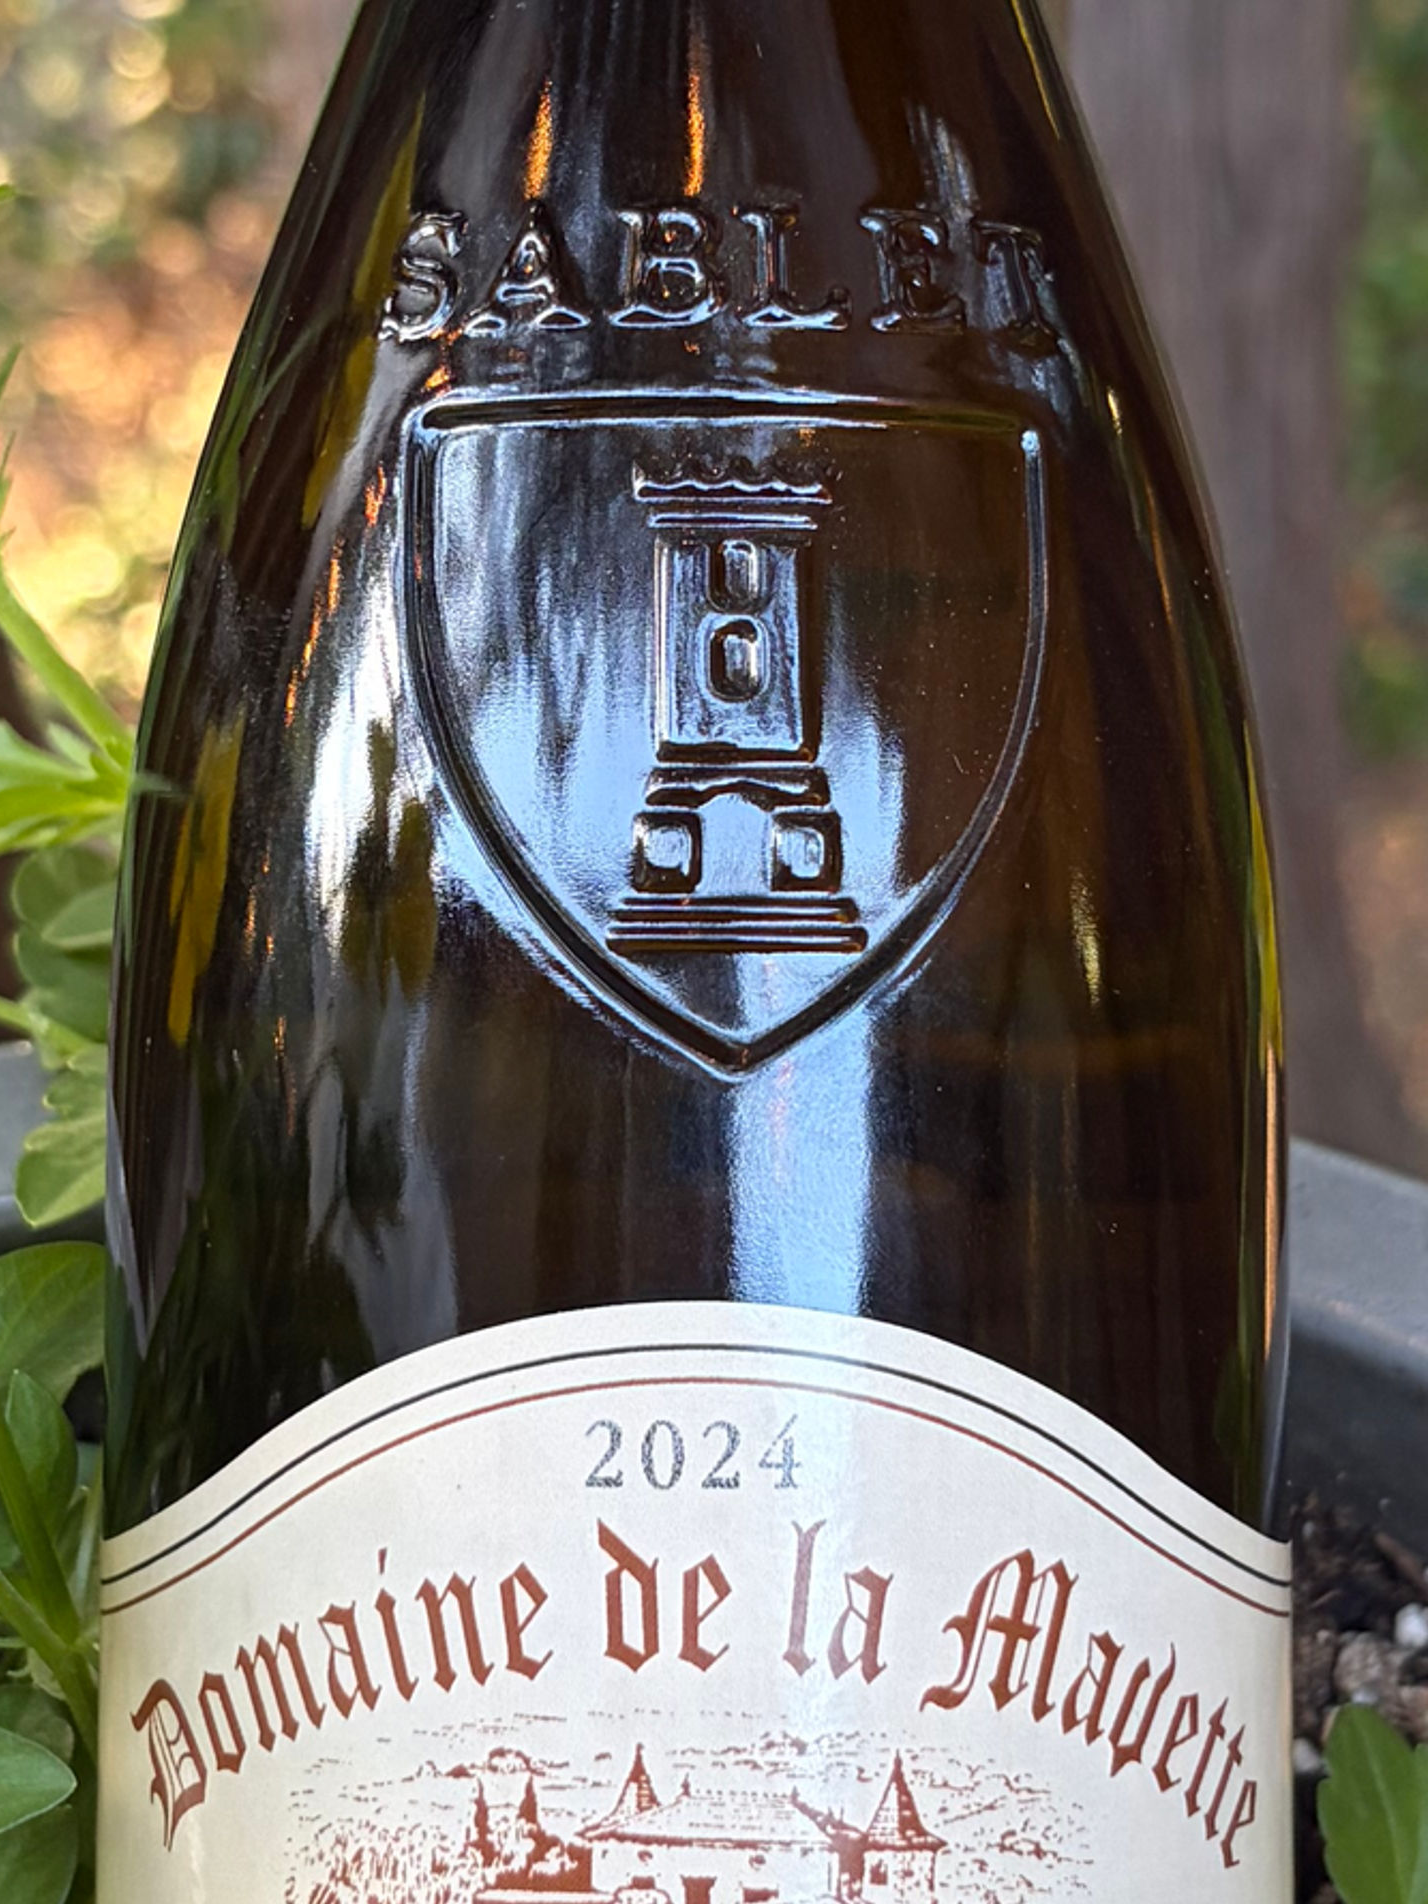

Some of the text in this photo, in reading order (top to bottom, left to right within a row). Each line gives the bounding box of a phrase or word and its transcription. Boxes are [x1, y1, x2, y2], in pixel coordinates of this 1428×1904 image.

[378, 198, 1058, 348] SABLET
[584, 1414, 804, 1491] 2024
[129, 1546, 554, 1853] Domaine
[597, 1517, 732, 1673] de
[782, 1517, 895, 1686] la
